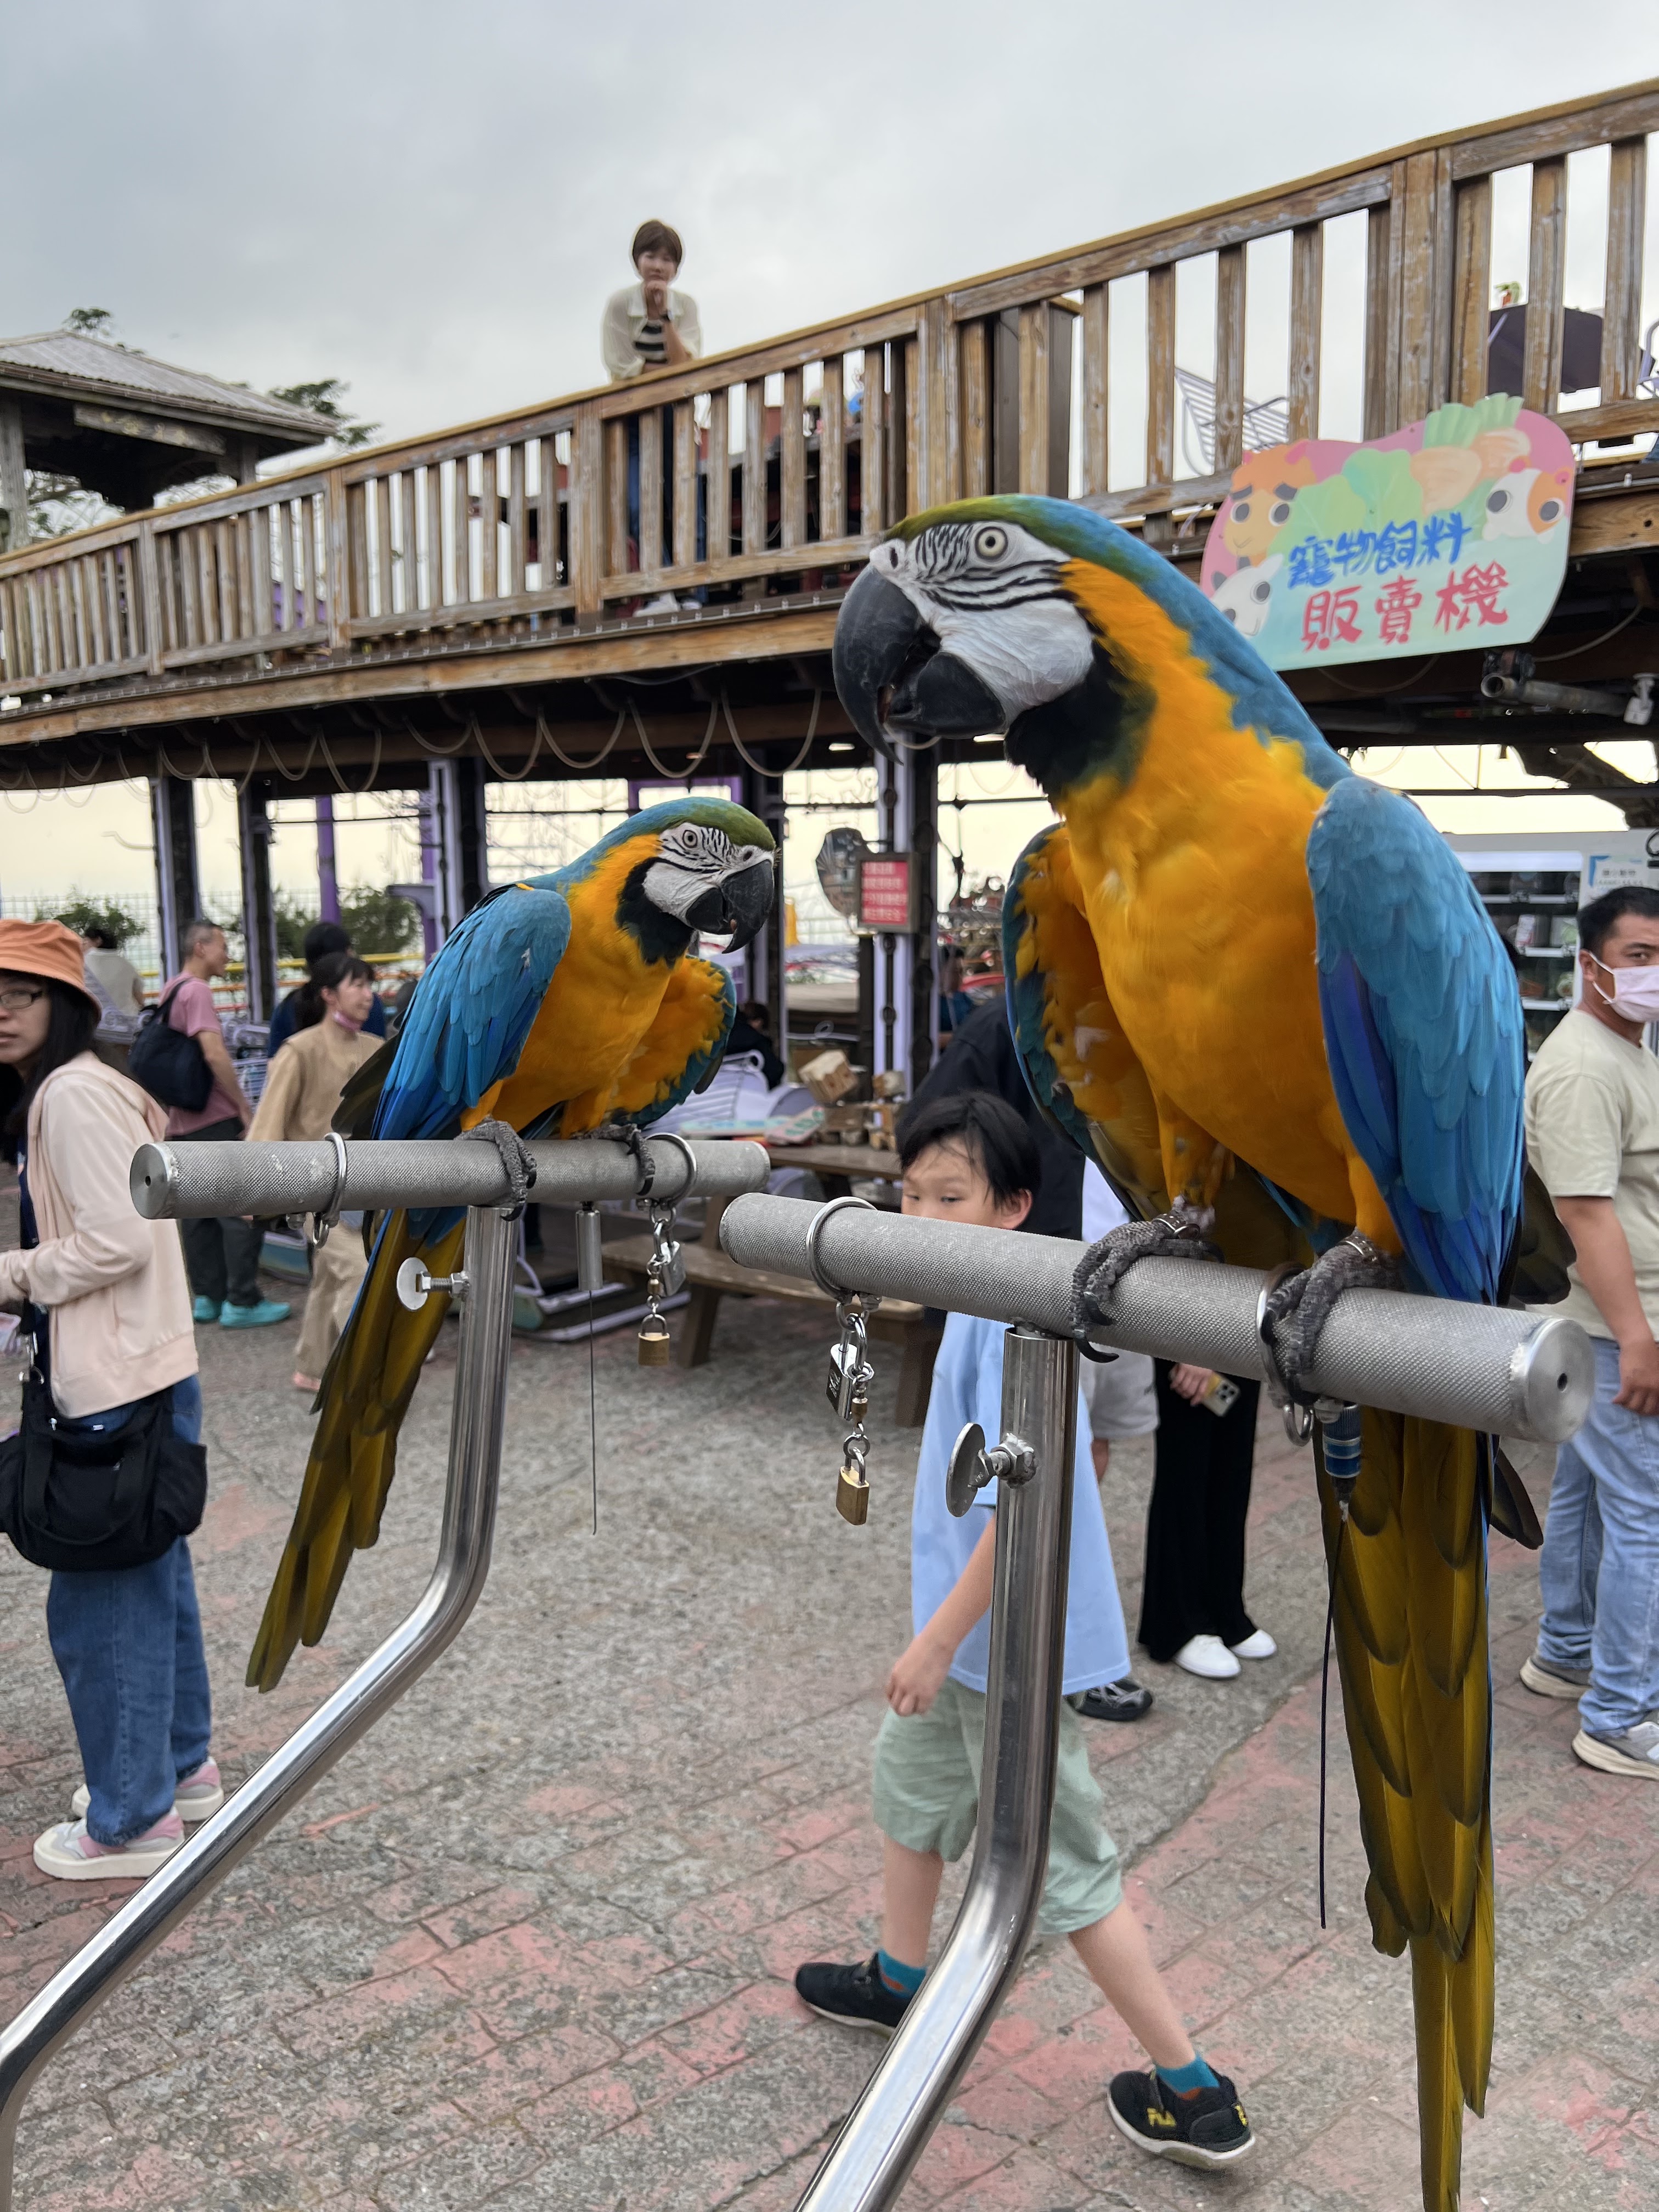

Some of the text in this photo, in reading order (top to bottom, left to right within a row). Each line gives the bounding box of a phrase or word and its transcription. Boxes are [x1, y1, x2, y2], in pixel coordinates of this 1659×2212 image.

[1288, 512, 1471, 589] 寵物飼料
[1302, 561, 1509, 652] 販賣機
